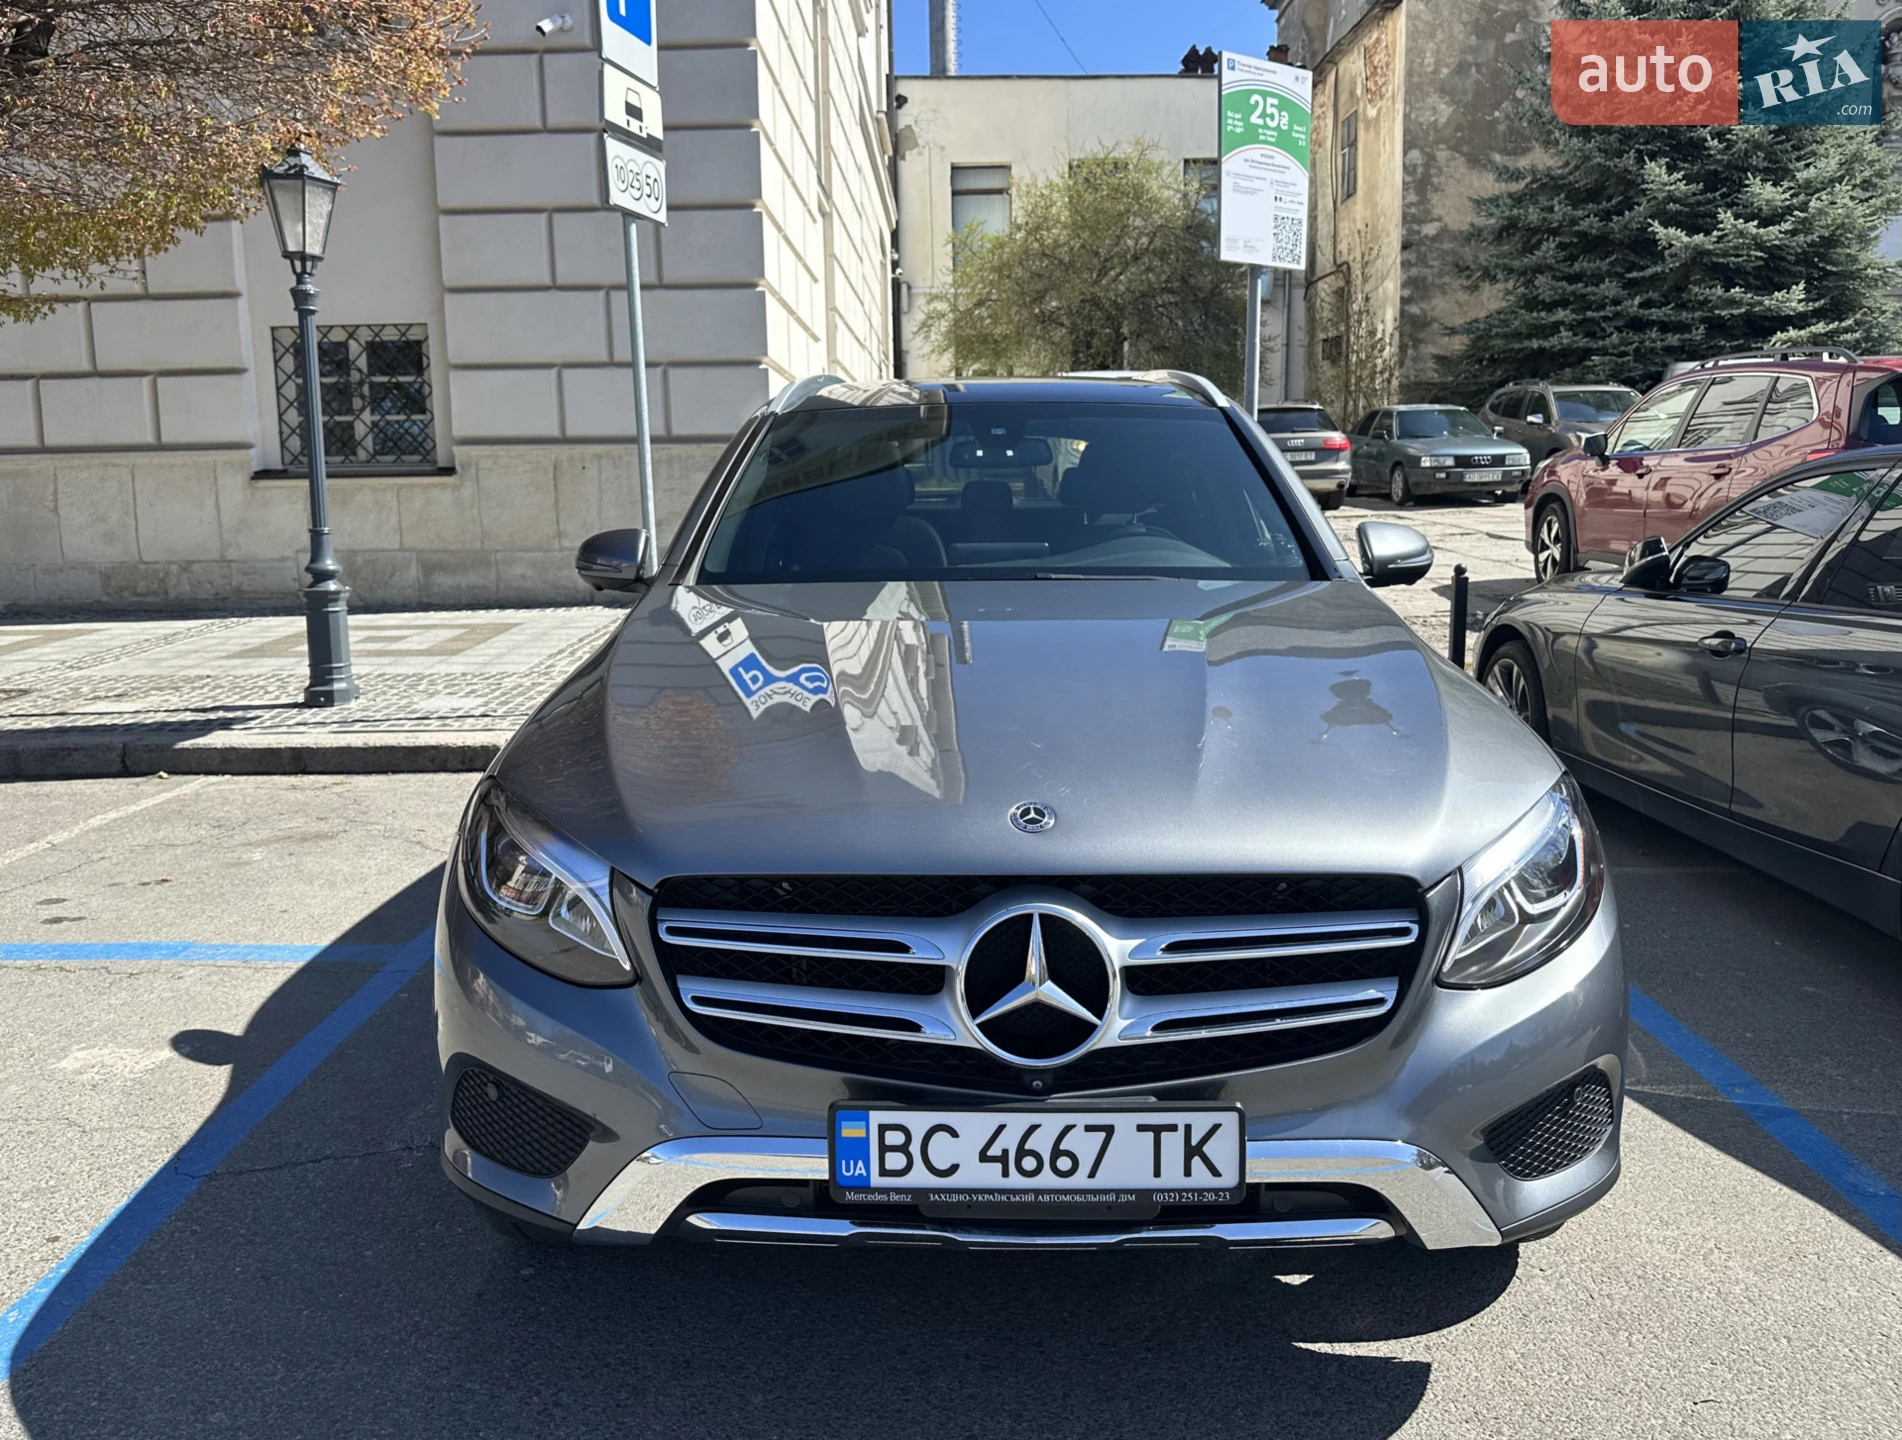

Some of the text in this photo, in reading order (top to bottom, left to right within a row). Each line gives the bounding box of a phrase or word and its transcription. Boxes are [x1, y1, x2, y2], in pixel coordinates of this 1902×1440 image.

[615, 164, 660, 202] 10 25 50
[877, 1123, 1223, 1179] BC 4667 TK
[841, 1160, 867, 1177] UA
[845, 1191, 912, 1202] Mercedes-Benz
[928, 1192, 1136, 1202] ЗАХІДНО-УКРАЇНСЬКИЙ АВТОМОБІЛЬНИЙ ДІМ
[1153, 1191, 1231, 1203] (032) 251-20-23
